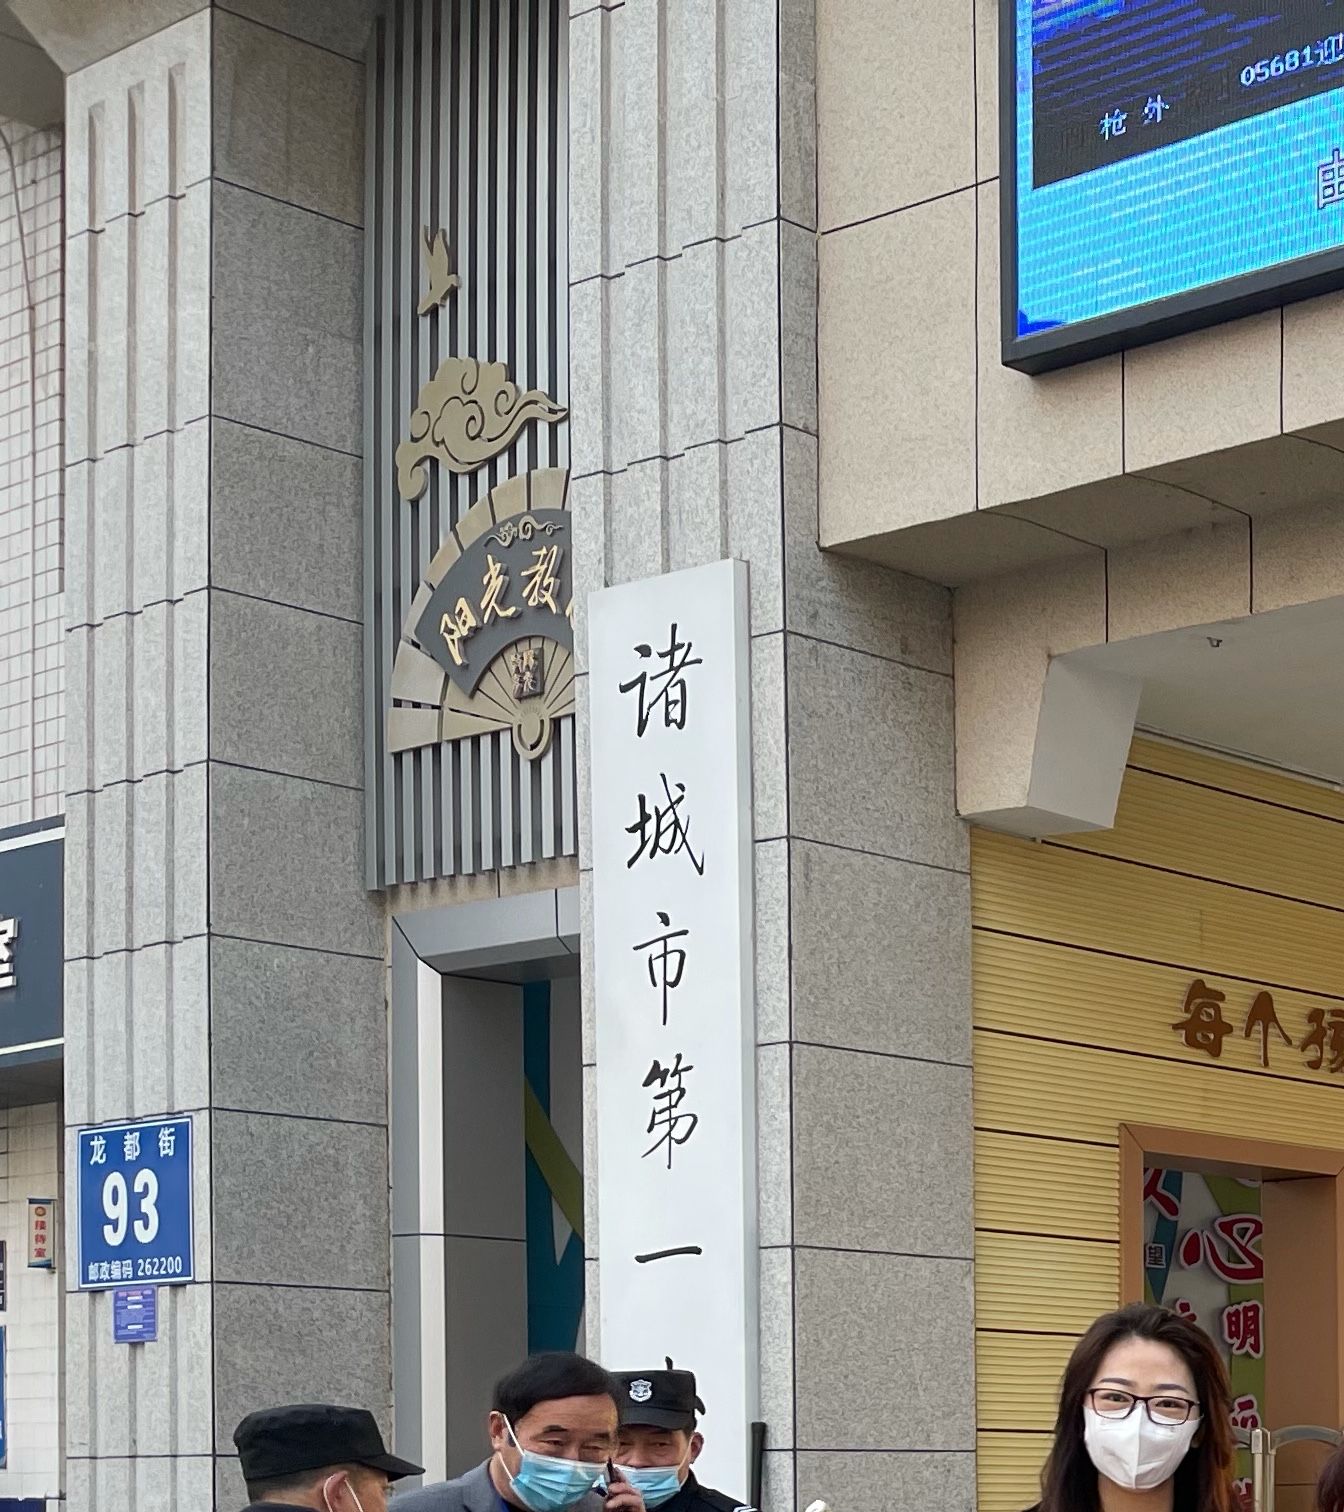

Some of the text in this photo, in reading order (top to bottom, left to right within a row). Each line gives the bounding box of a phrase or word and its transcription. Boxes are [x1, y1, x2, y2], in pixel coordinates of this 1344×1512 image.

[440, 545, 574, 666] 阳光教
[619, 622, 704, 1370] 诸城市第一
[90, 1127, 176, 1166] 龙都街
[102, 1168, 159, 1246] 93
[88, 1255, 183, 1281] 邮政编码 262200
[1225, 1303, 1261, 1355] 明
